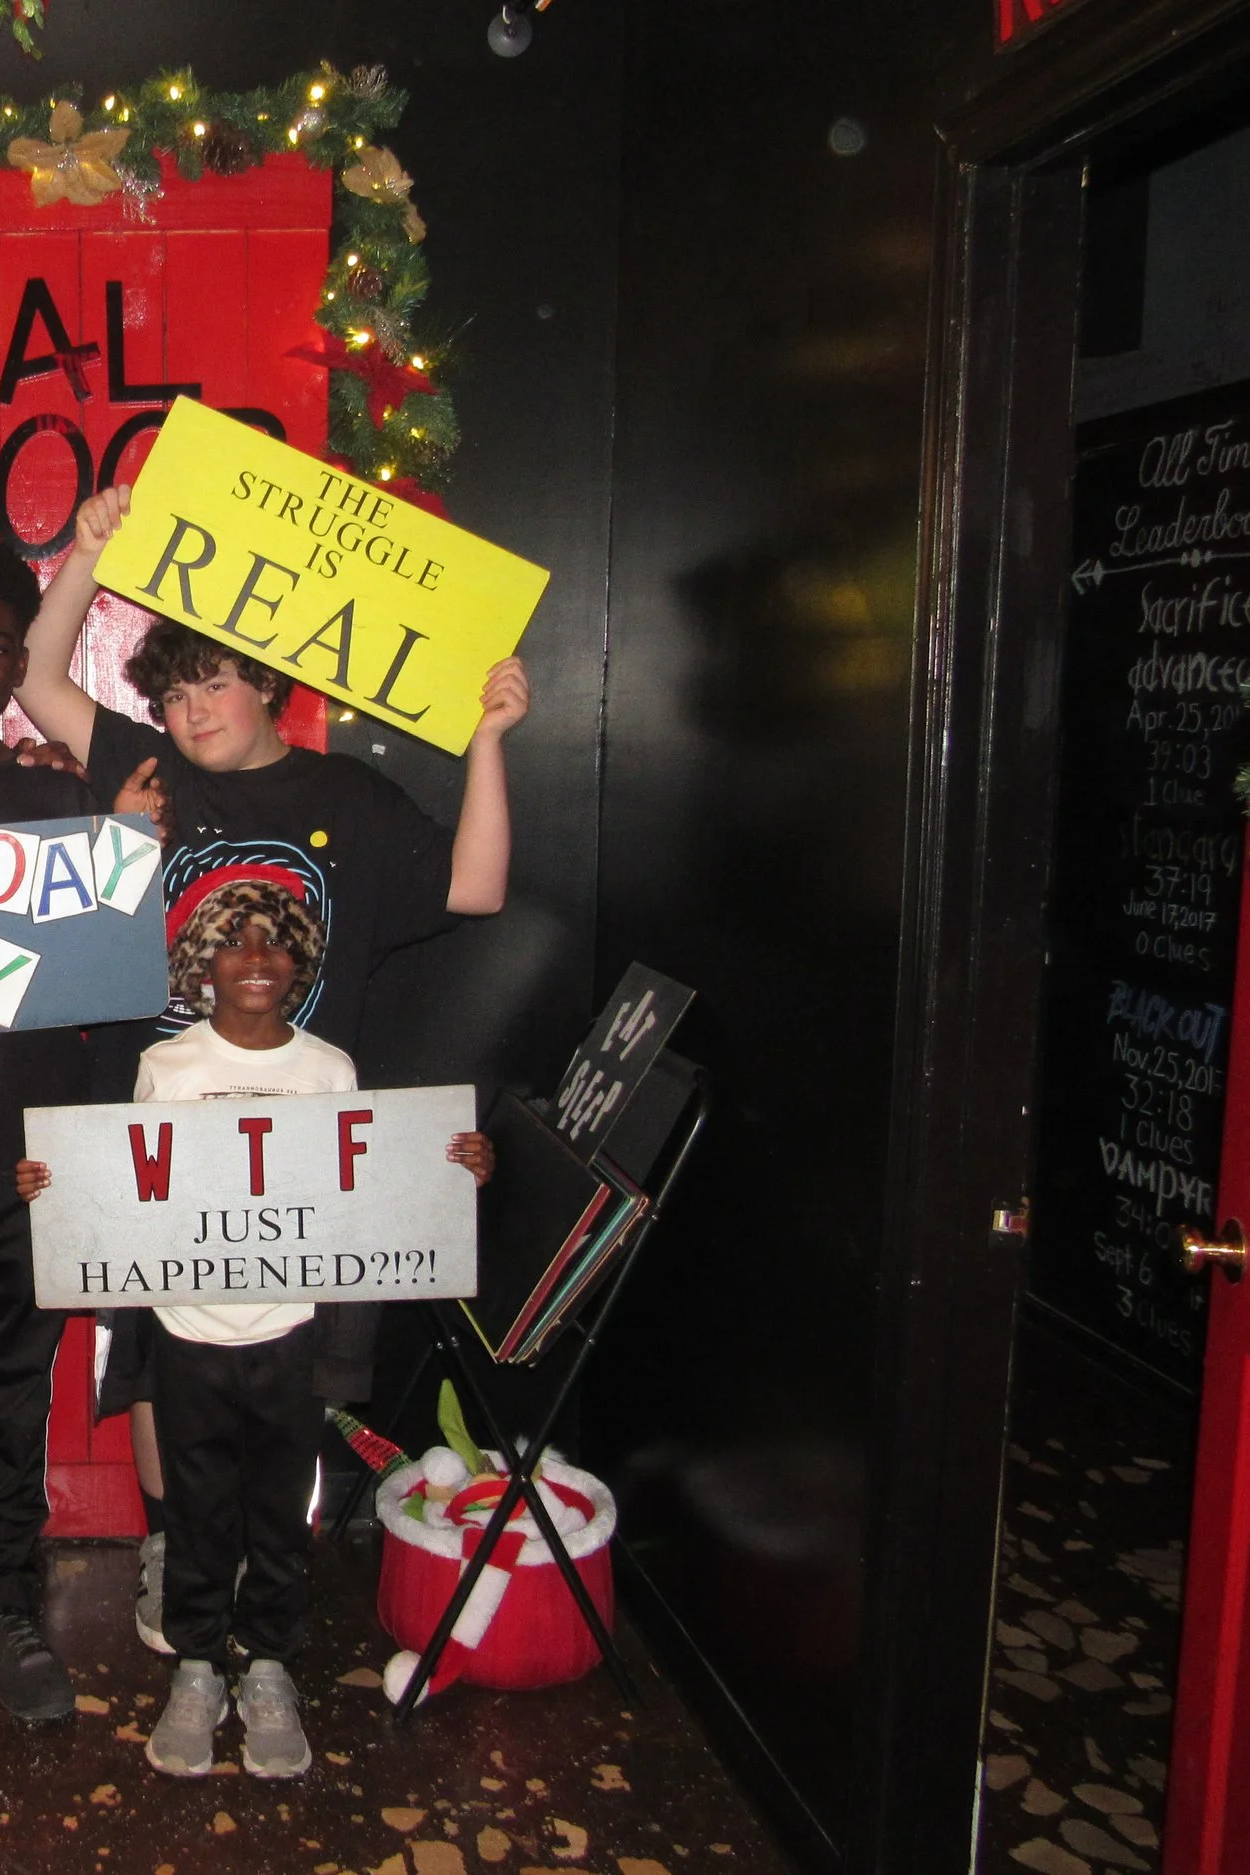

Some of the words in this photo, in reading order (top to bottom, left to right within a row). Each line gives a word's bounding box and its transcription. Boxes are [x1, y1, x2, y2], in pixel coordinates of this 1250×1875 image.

[1139, 425, 1197, 487] All
[1197, 416, 1250, 475] Tim
[319, 470, 395, 529] THE
[231, 470, 445, 592] STRUGGLE
[304, 543, 343, 579] IS
[135, 513, 431, 723] REAL
[1122, 888, 1158, 919] June
[1144, 864, 1212, 906] 37:19
[1153, 935, 1212, 972] Clues
[600, 990, 656, 1061] EAT
[557, 1059, 623, 1142] SLEEP
[1121, 1072, 1193, 1131] 32:18
[1136, 1120, 1194, 1165] Clues
[193, 1206, 315, 1244] JUST
[1114, 1194, 1172, 1250] 34:0
[78, 1249, 437, 1294] HAPPENED?!?!
